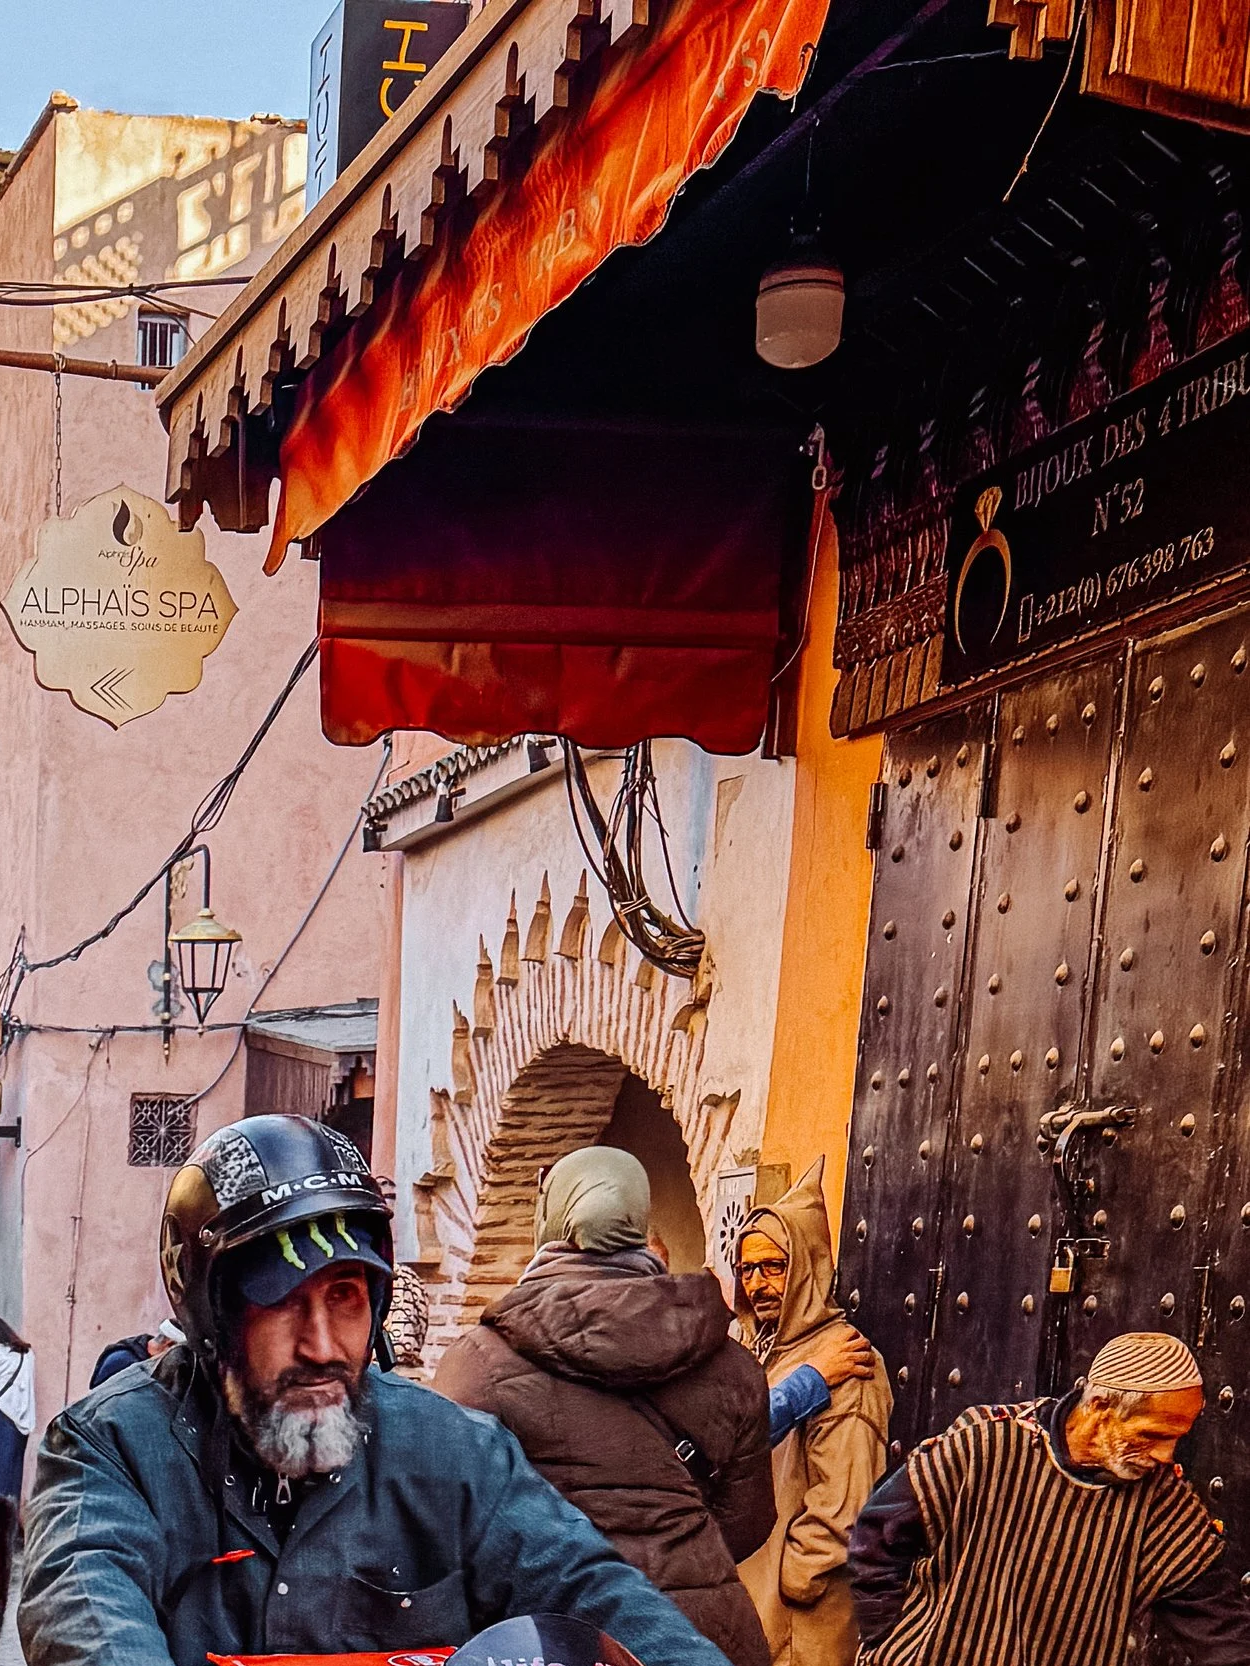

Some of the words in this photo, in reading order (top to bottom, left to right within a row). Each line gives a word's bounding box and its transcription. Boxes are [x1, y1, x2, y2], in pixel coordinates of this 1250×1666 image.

[1014, 435, 1093, 511] BIJOUX
[1101, 407, 1146, 467] DES
[119, 546, 159, 577] Spa
[20, 584, 150, 618] ALPHAÏS
[159, 590, 219, 620] SPA
[164, 623, 178, 632] DE
